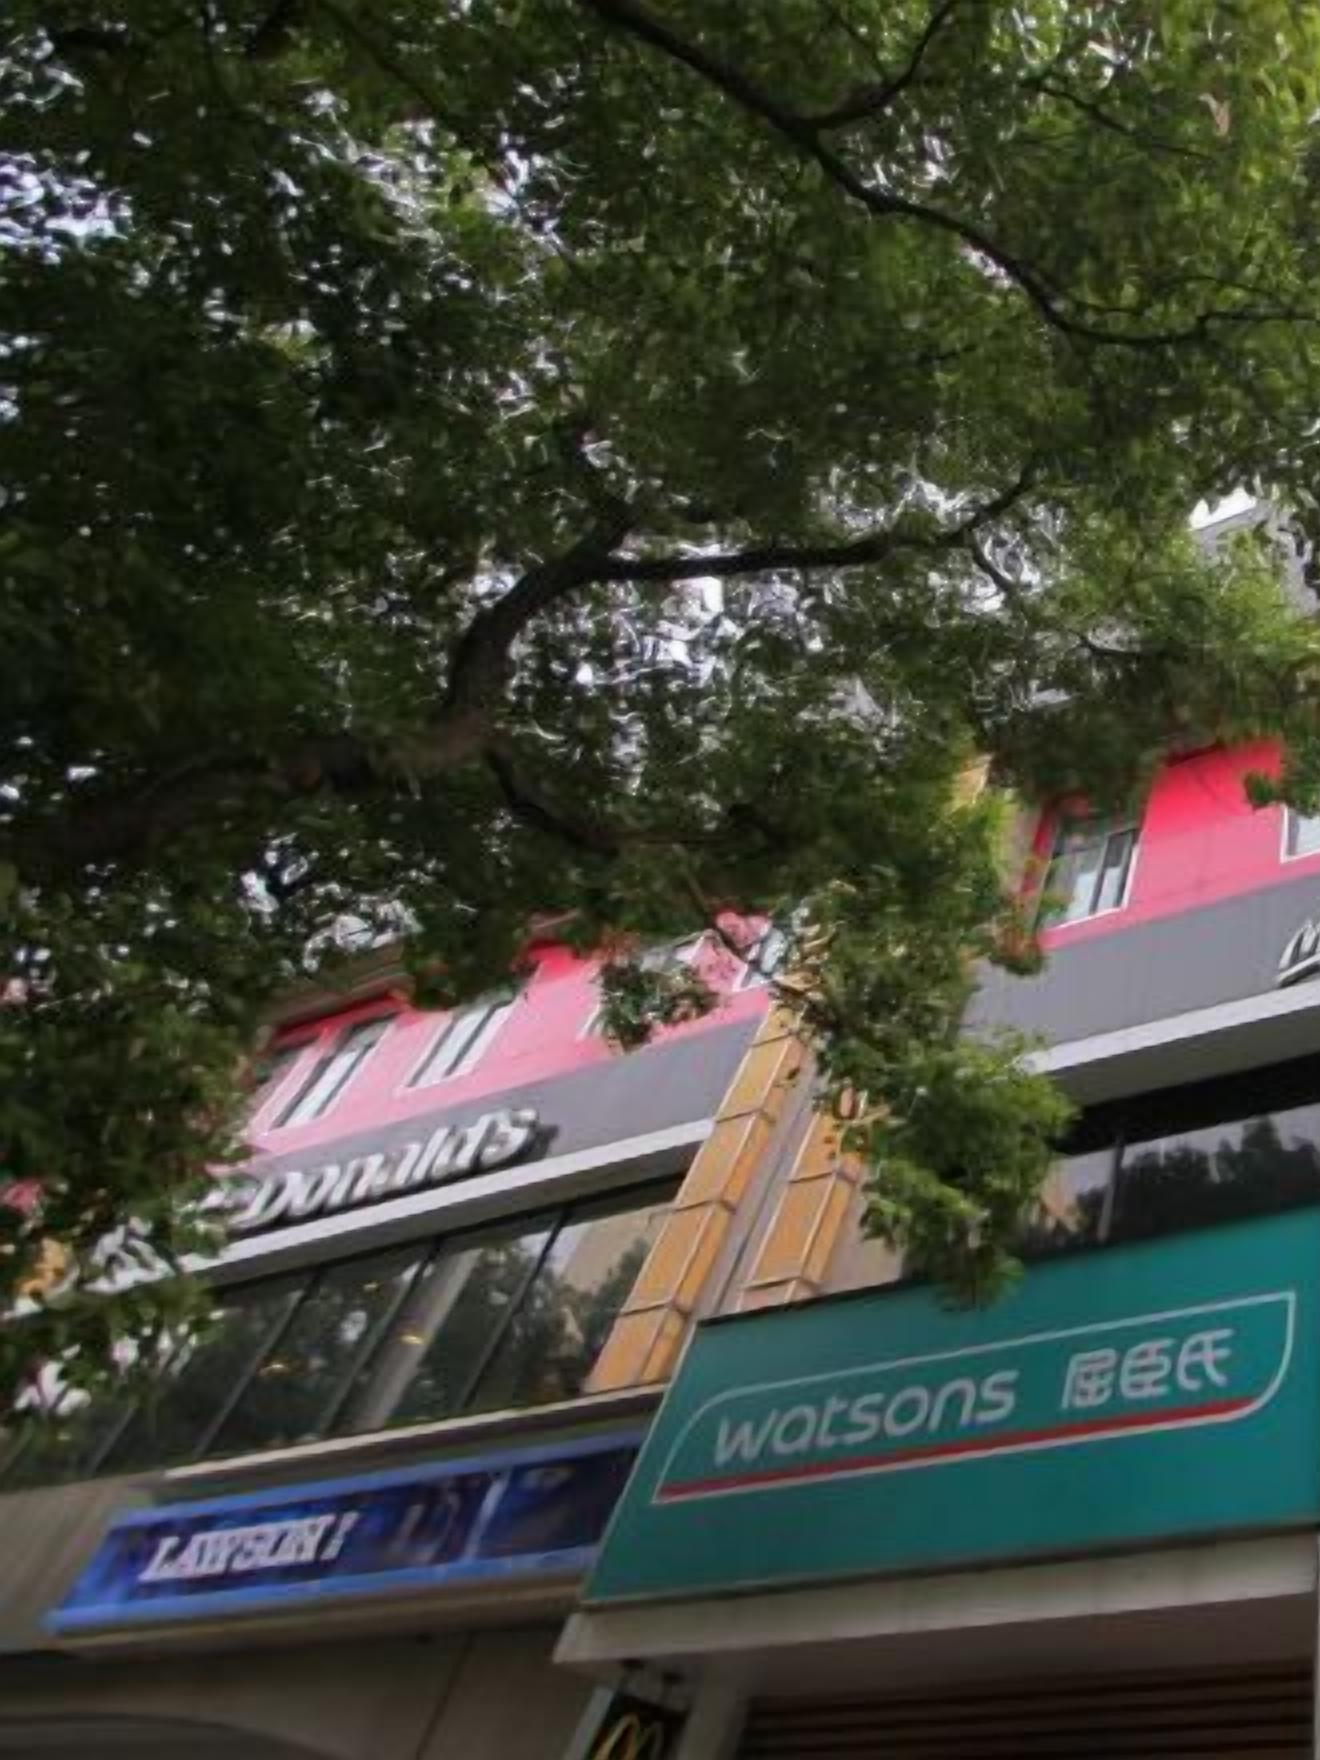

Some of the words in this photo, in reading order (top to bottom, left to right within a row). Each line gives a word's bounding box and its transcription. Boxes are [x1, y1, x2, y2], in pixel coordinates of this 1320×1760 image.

[712, 1369, 1020, 1468] watsons
[1060, 1328, 1235, 1411] 屈臣氏
